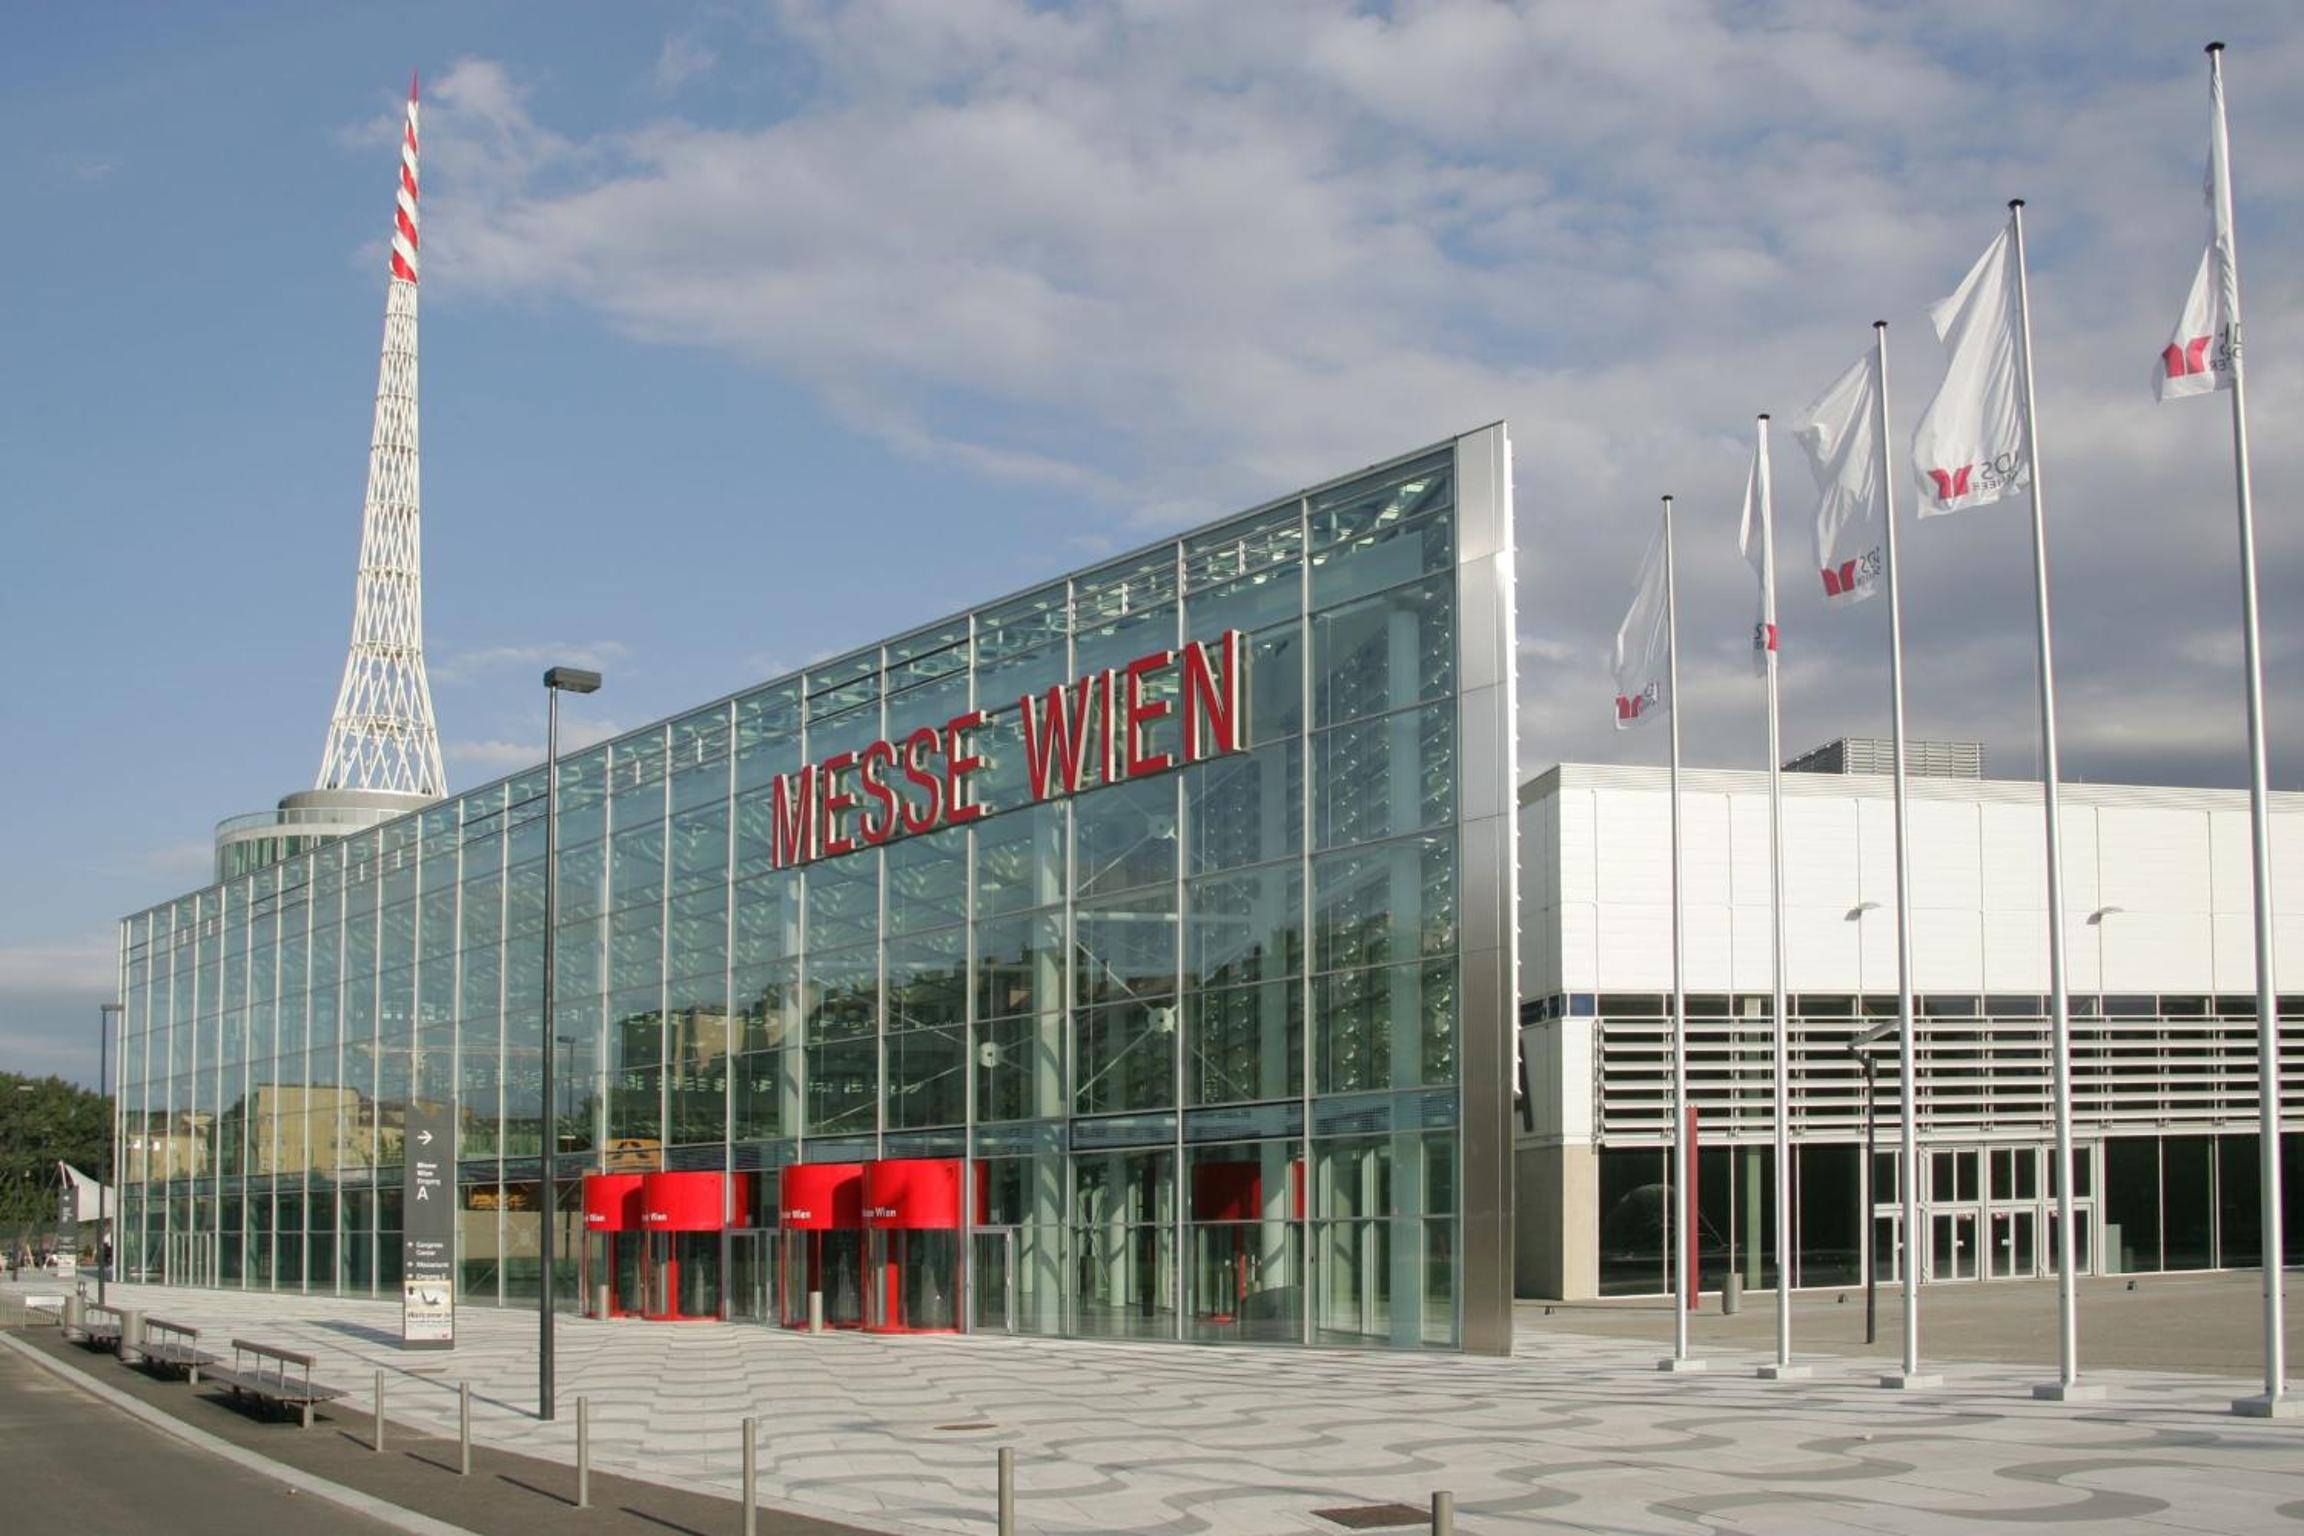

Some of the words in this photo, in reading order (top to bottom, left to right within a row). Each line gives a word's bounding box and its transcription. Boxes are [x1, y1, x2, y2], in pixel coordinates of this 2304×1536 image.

[772, 710, 989, 869] MESSE
[1020, 629, 1242, 800] WIEN
[416, 1186, 429, 1200] A
[875, 1206, 897, 1217] Wien
